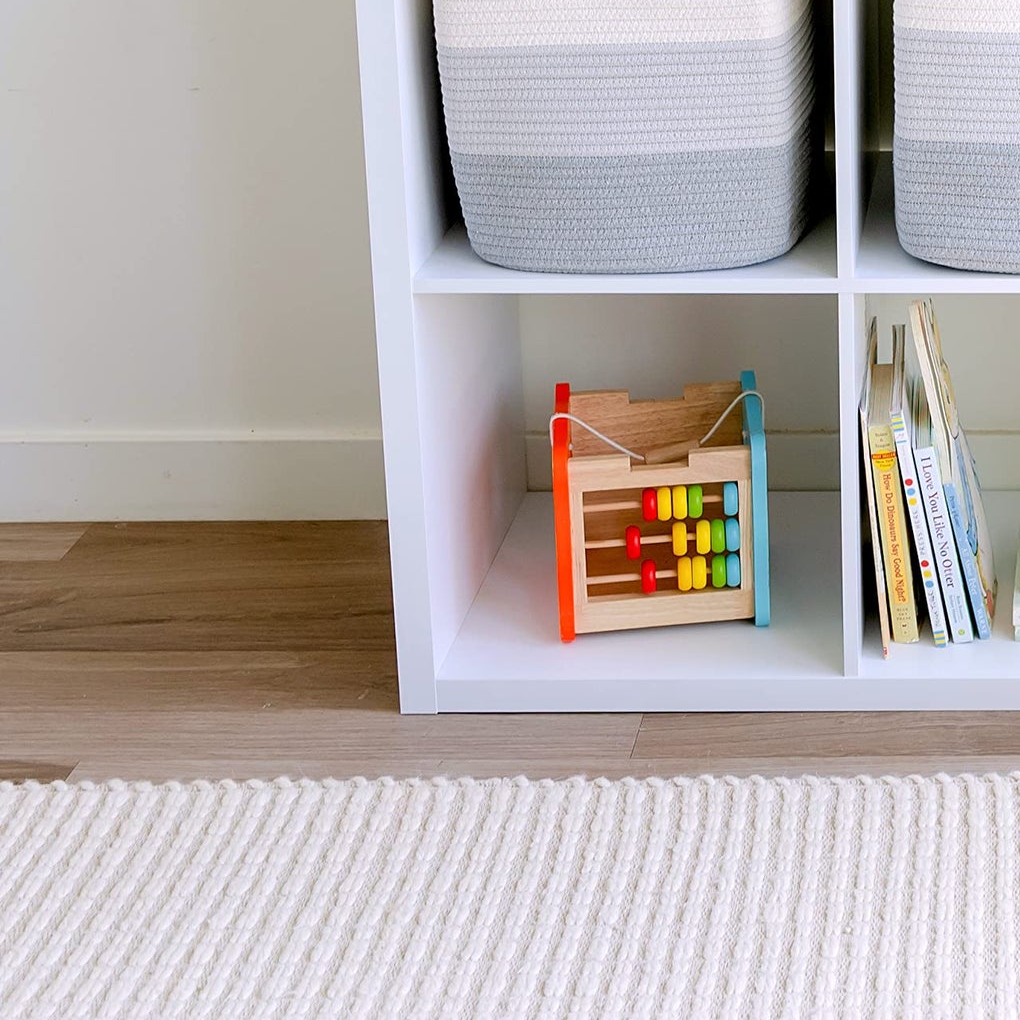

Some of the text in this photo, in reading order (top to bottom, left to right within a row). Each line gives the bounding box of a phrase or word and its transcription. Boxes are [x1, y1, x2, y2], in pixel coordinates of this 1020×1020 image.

[882, 473, 892, 491] How
[922, 465, 934, 490] Love
[885, 492, 894, 504] Do
[928, 492, 939, 513] You
[886, 506, 897, 542] Dinosaurs
[933, 515, 945, 539] Like
[891, 544, 900, 556] Say
[938, 541, 949, 557] No
[893, 559, 904, 578] Good
[942, 559, 954, 588] Otter
[895, 580, 906, 602] Night?
